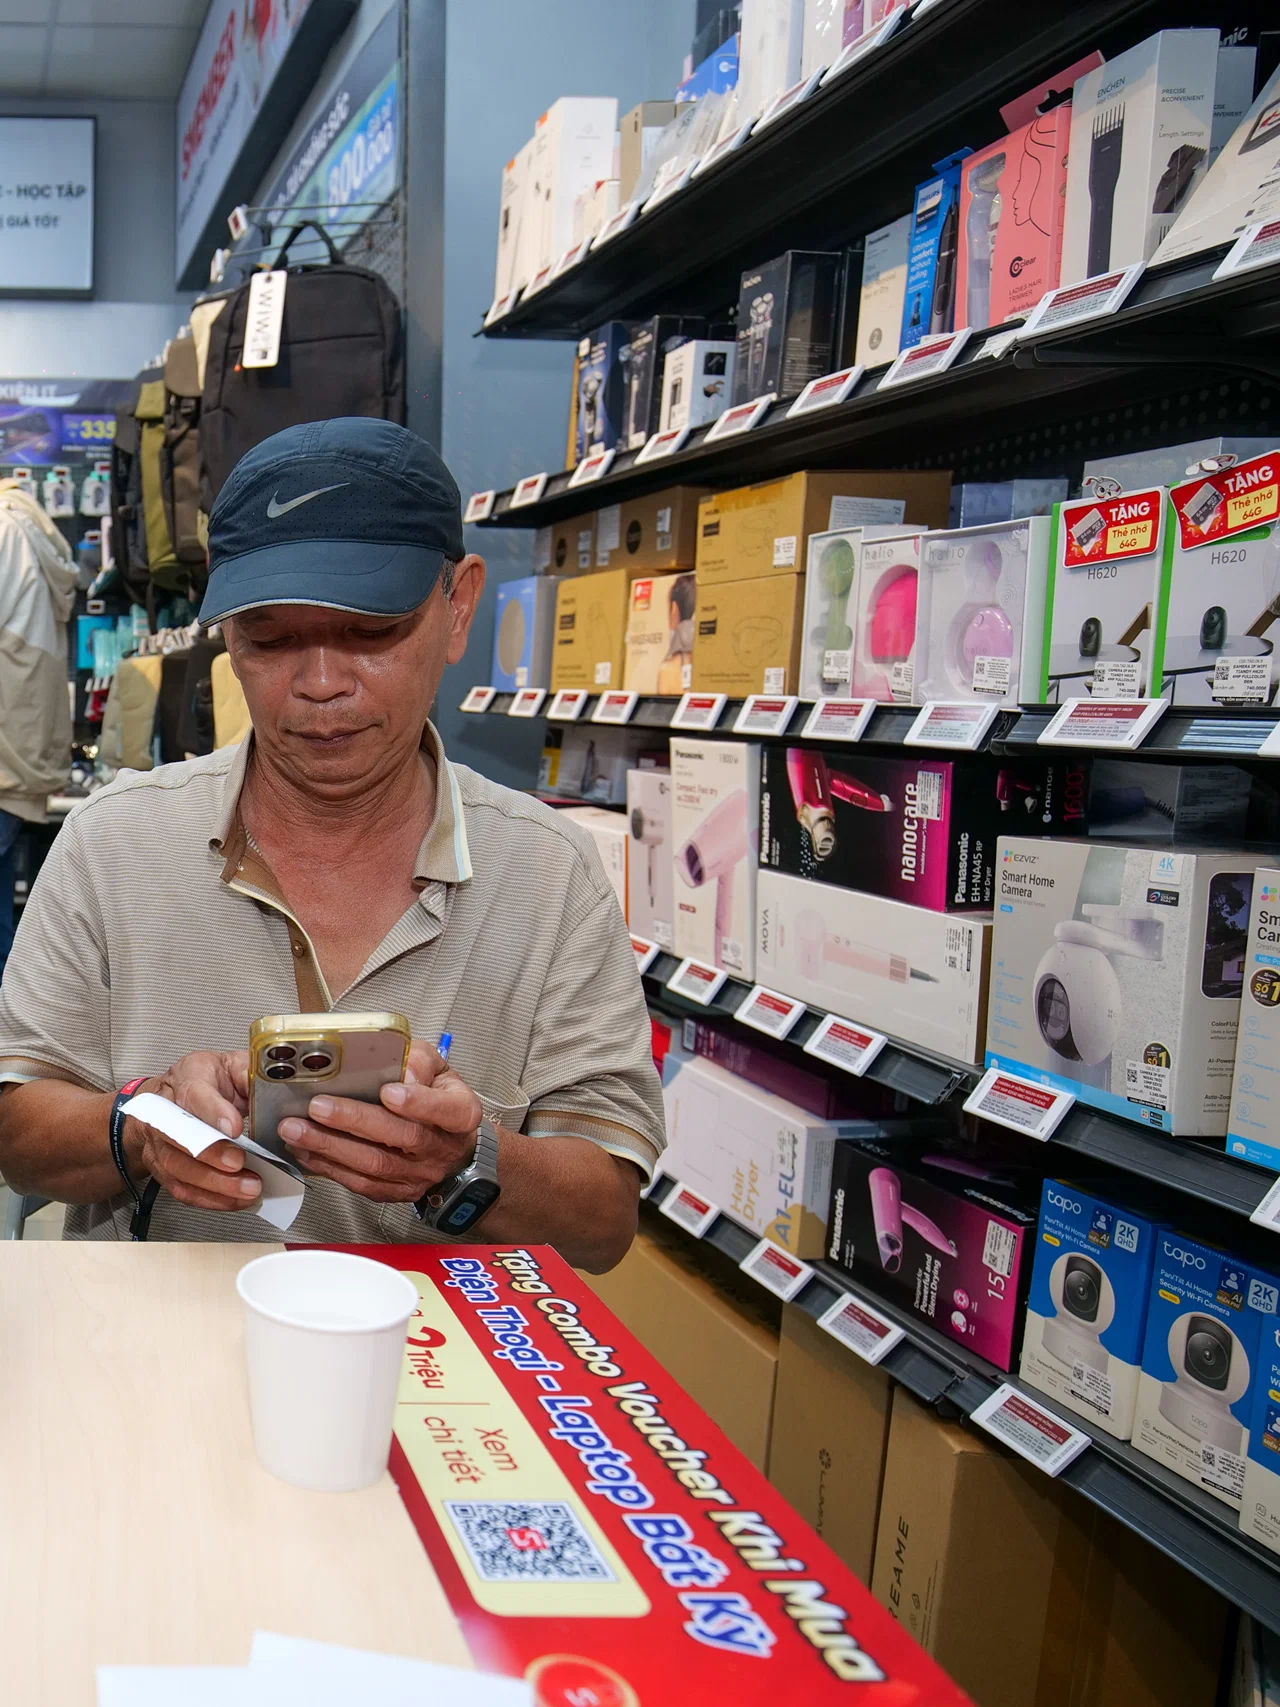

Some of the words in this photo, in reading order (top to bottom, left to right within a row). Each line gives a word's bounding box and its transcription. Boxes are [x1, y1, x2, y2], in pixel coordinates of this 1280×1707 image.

[1159, 131, 1178, 139] Length
[1181, 130, 1204, 138] Settings
[16, 183, 53, 202] HỌC
[57, 180, 87, 201] TẬP
[7, 212, 30, 228] GIÁ
[34, 212, 60, 228] TỐT
[1225, 465, 1273, 499] TẶNG
[1109, 501, 1151, 524] TẶNG
[1232, 497, 1251, 511] Thẻ
[1253, 490, 1274, 505] nhớ
[1242, 507, 1262, 520] 64G
[1112, 526, 1129, 539] Thẻ
[1130, 524, 1148, 536] nhớ
[1119, 538, 1137, 550] 64G
[865, 546, 894, 561] halio
[928, 543, 965, 561] halio
[1211, 549, 1246, 565] H620
[1087, 566, 1118, 580] H620
[676, 750, 704, 760] Panasonic
[761, 792, 770, 863] Panasonic
[901, 782, 920, 882] nanocare
[976, 840, 983, 852] RP
[955, 832, 969, 903] Panasonic
[1159, 857, 1173, 871] 4K
[971, 853, 982, 902] EH-NA45
[1002, 870, 1027, 885] Smart
[1029, 874, 1055, 888] Home
[1001, 883, 1032, 898] Camera
[762, 908, 770, 954] MOVA
[731, 1168, 744, 1213] Hair
[743, 1160, 760, 1222] Dryer
[1047, 1189, 1081, 1215] tapo
[830, 1188, 845, 1261] Panasonic
[1044, 1215, 1064, 1230] Pan/Tilt
[1071, 1226, 1087, 1240] Home
[1118, 1224, 1136, 1241] 2K
[1043, 1223, 1064, 1240] Security
[1065, 1232, 1079, 1245] Wi-Fi
[1079, 1238, 1100, 1255] Camera
[1117, 1236, 1134, 1250] QHD
[1163, 1240, 1206, 1271] tapo
[931, 1259, 942, 1290] Drying
[1160, 1269, 1185, 1285] Pan/Tilt
[1186, 1279, 1193, 1289] AI
[1193, 1282, 1213, 1298] Home
[920, 1274, 931, 1313] Powerful
[927, 1291, 938, 1317] Silent
[1159, 1278, 1186, 1298] Security
[1187, 1290, 1203, 1304] Wi-Fi
[1204, 1297, 1230, 1317] Camera
[1232, 1292, 1243, 1303] AI
[1251, 1297, 1273, 1313] QHD
[1252, 1284, 1274, 1303] 2K
[407, 1350, 445, 1390] Triệu
[424, 1416, 464, 1444] chi
[440, 1257, 499, 1303] Điện
[476, 1305, 564, 1371] Thoại
[537, 1395, 656, 1510] Laptop
[621, 1513, 730, 1588] Bất
[677, 1591, 777, 1658] Kỳ
[474, 1427, 519, 1473] Xem
[442, 1443, 487, 1485] tiết
[491, 1248, 554, 1294] Tặng
[536, 1296, 622, 1378] Combo
[605, 1381, 735, 1505] Voucher
[707, 1510, 805, 1572] Khi
[763, 1579, 888, 1682] Mua
